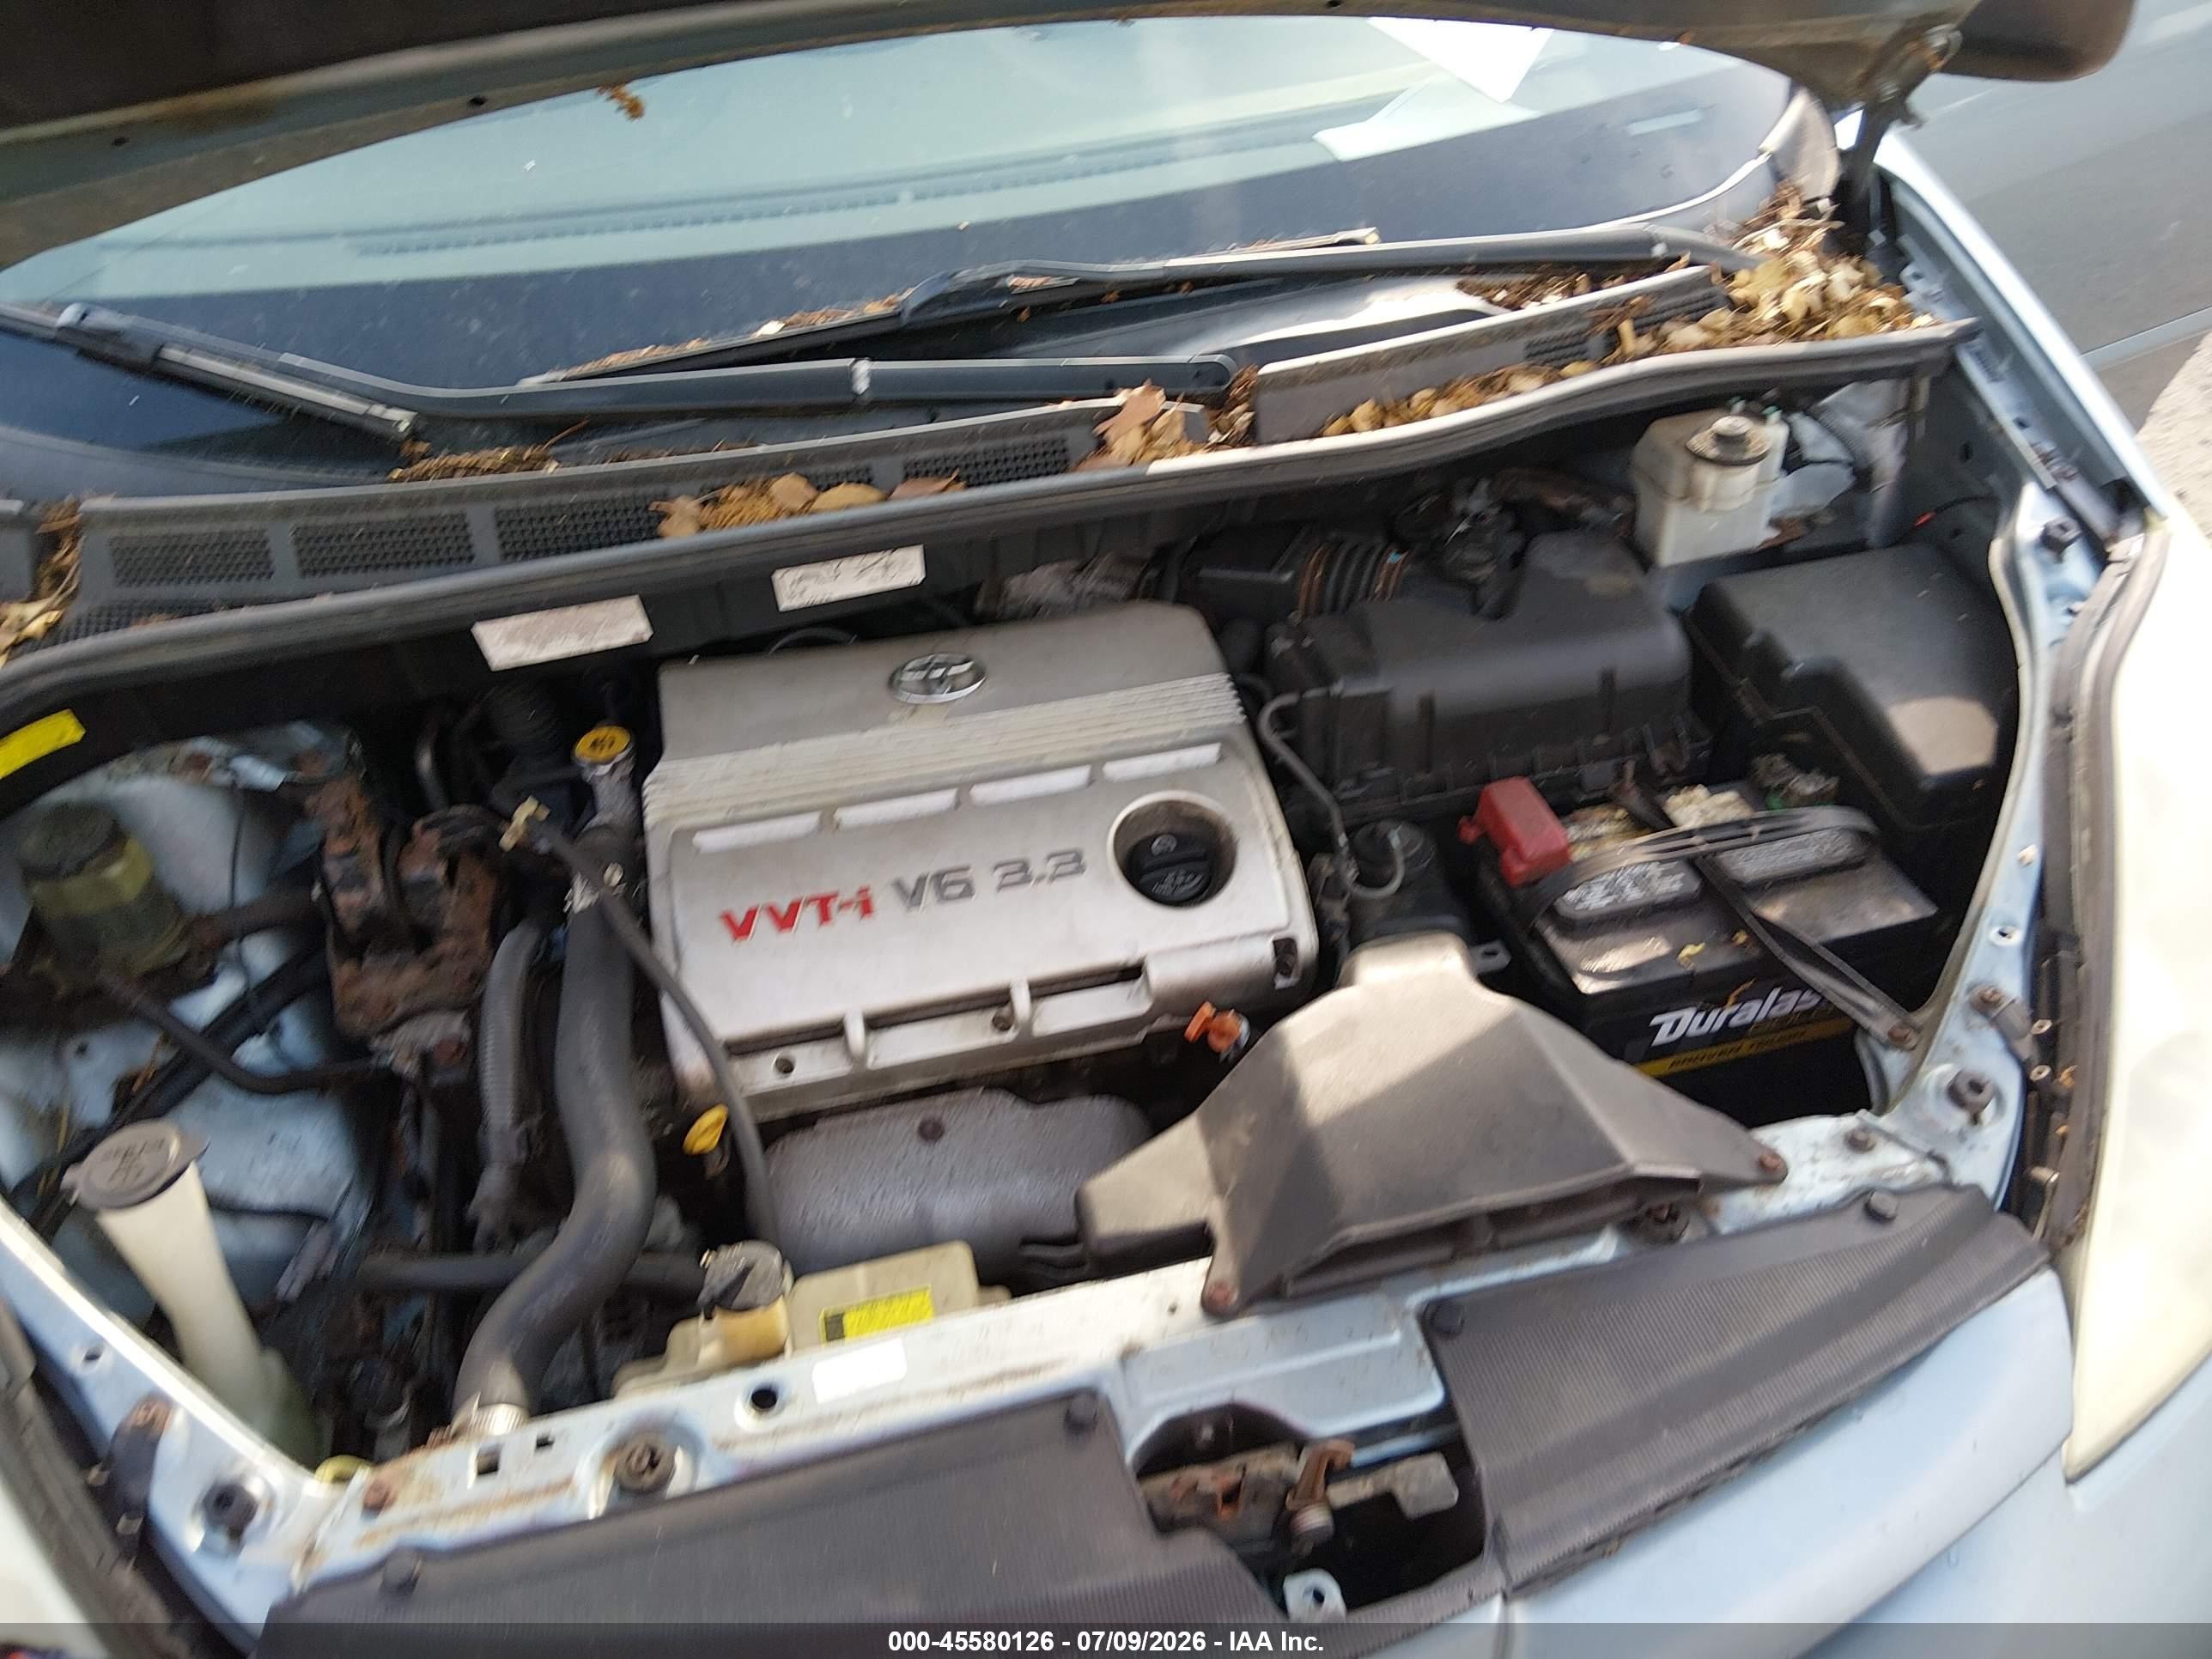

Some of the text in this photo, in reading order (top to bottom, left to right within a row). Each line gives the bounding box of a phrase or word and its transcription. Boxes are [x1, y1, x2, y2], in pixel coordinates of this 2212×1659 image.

[720, 848, 1087, 941] VVT-i V6 3.3
[1649, 987, 1824, 1047] Duralas
